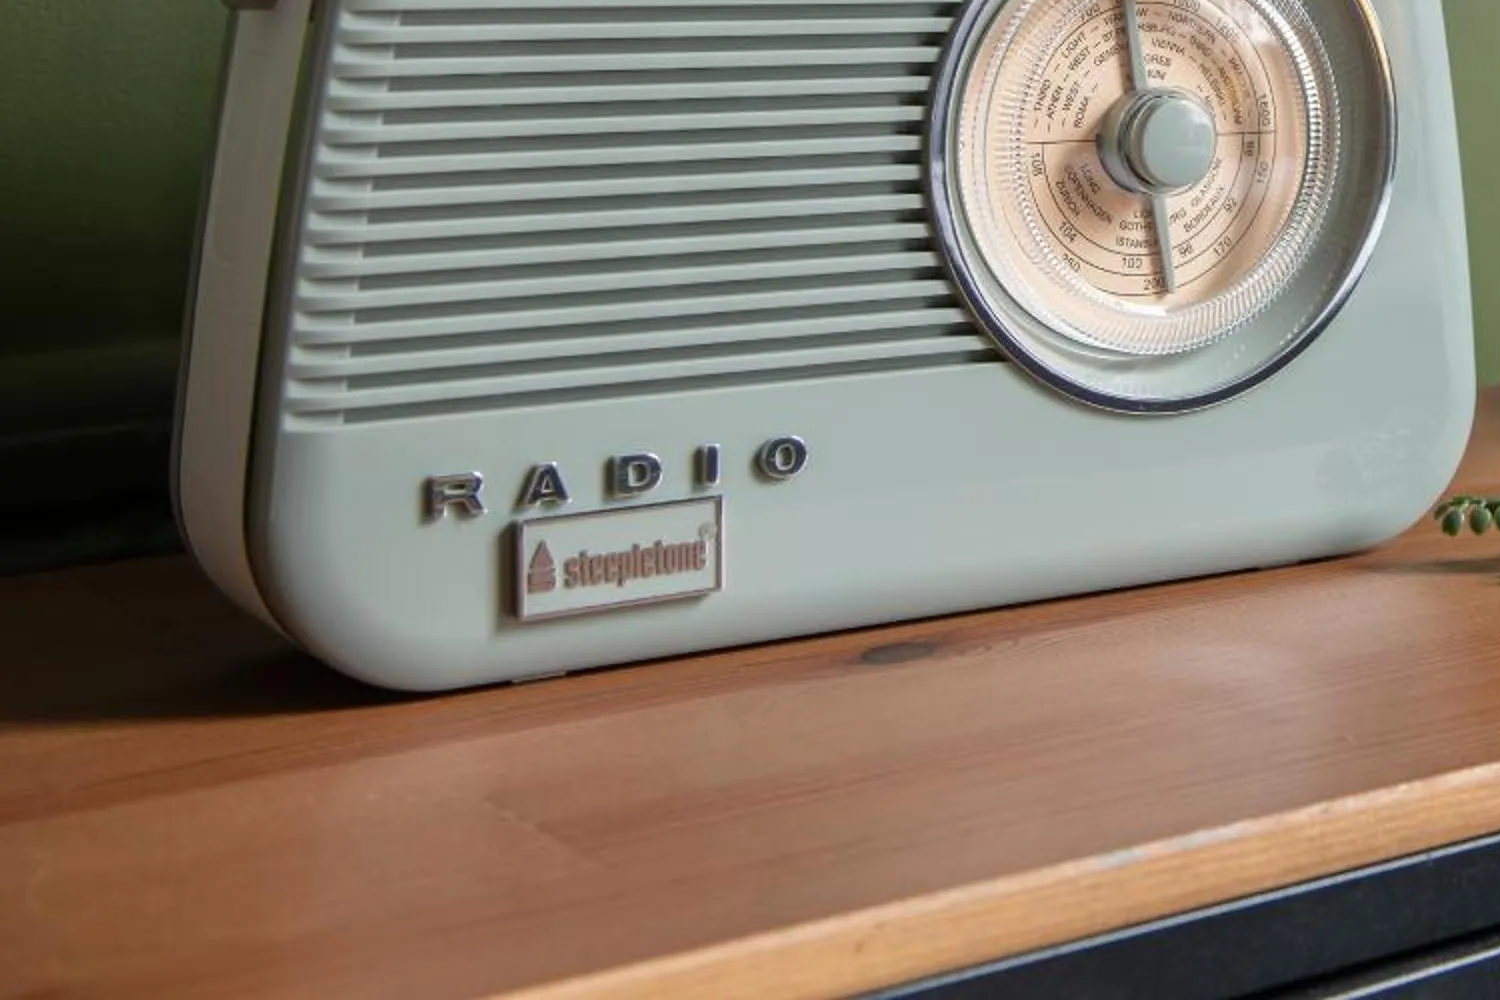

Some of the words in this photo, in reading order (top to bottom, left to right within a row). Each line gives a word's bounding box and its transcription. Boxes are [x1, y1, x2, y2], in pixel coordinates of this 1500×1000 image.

[1061, 31, 1087, 60] LIGHT
[1068, 46, 1091, 71] WEST
[1058, 221, 1078, 243] 104
[1213, 235, 1233, 257] 170
[424, 435, 808, 522] RADIO
[563, 540, 708, 589] steepletone
